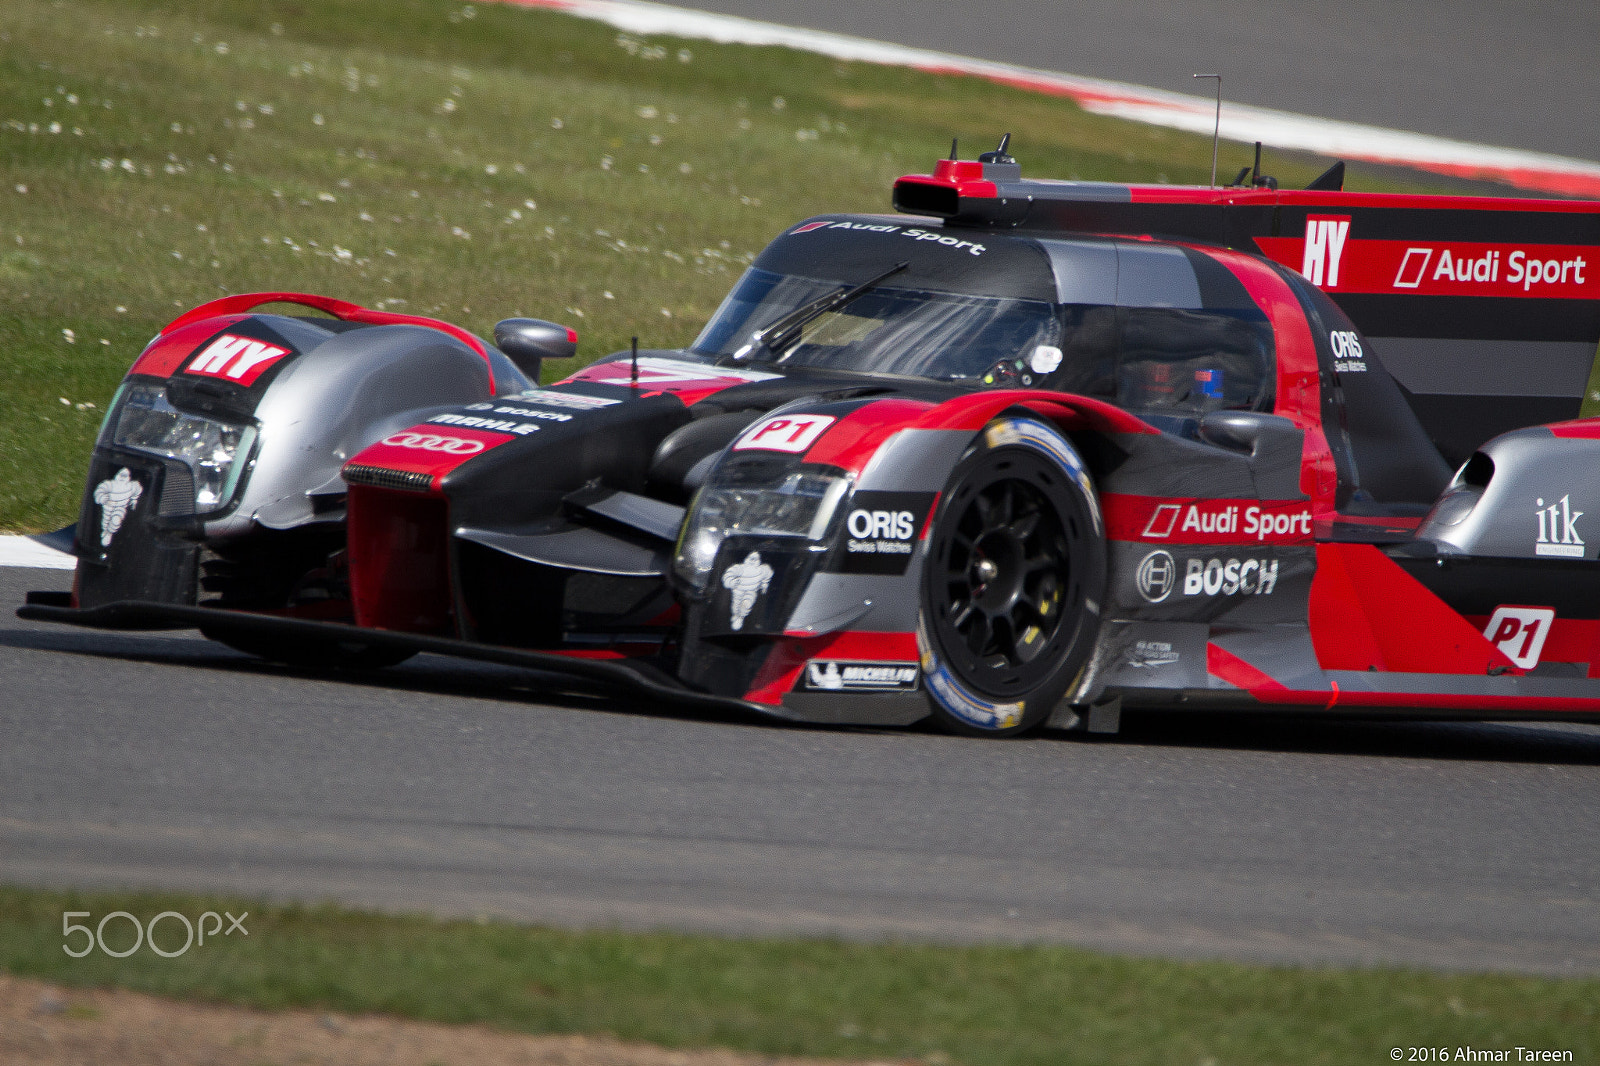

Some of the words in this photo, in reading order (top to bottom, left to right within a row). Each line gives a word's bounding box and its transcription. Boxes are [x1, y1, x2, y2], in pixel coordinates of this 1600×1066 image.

[829, 221, 901, 233] Audi
[1303, 220, 1349, 287] HY
[1433, 250, 1500, 282] Audi
[1506, 251, 1586, 291] Sport
[188, 335, 286, 379] HY
[1330, 330, 1363, 358] ORIS
[426, 414, 541, 436] MAHLE
[493, 405, 573, 422] BOSCH
[751, 420, 815, 442] P1
[847, 509, 914, 540] ORIS
[1182, 505, 1239, 533] Audi
[1243, 506, 1312, 541] Sport
[1535, 494, 1585, 545] itk
[847, 539, 877, 554] Swiss
[876, 540, 913, 554] Watches
[1184, 558, 1279, 596] BOSCH
[1491, 616, 1542, 660] P1
[842, 666, 918, 682] MICHELIN
